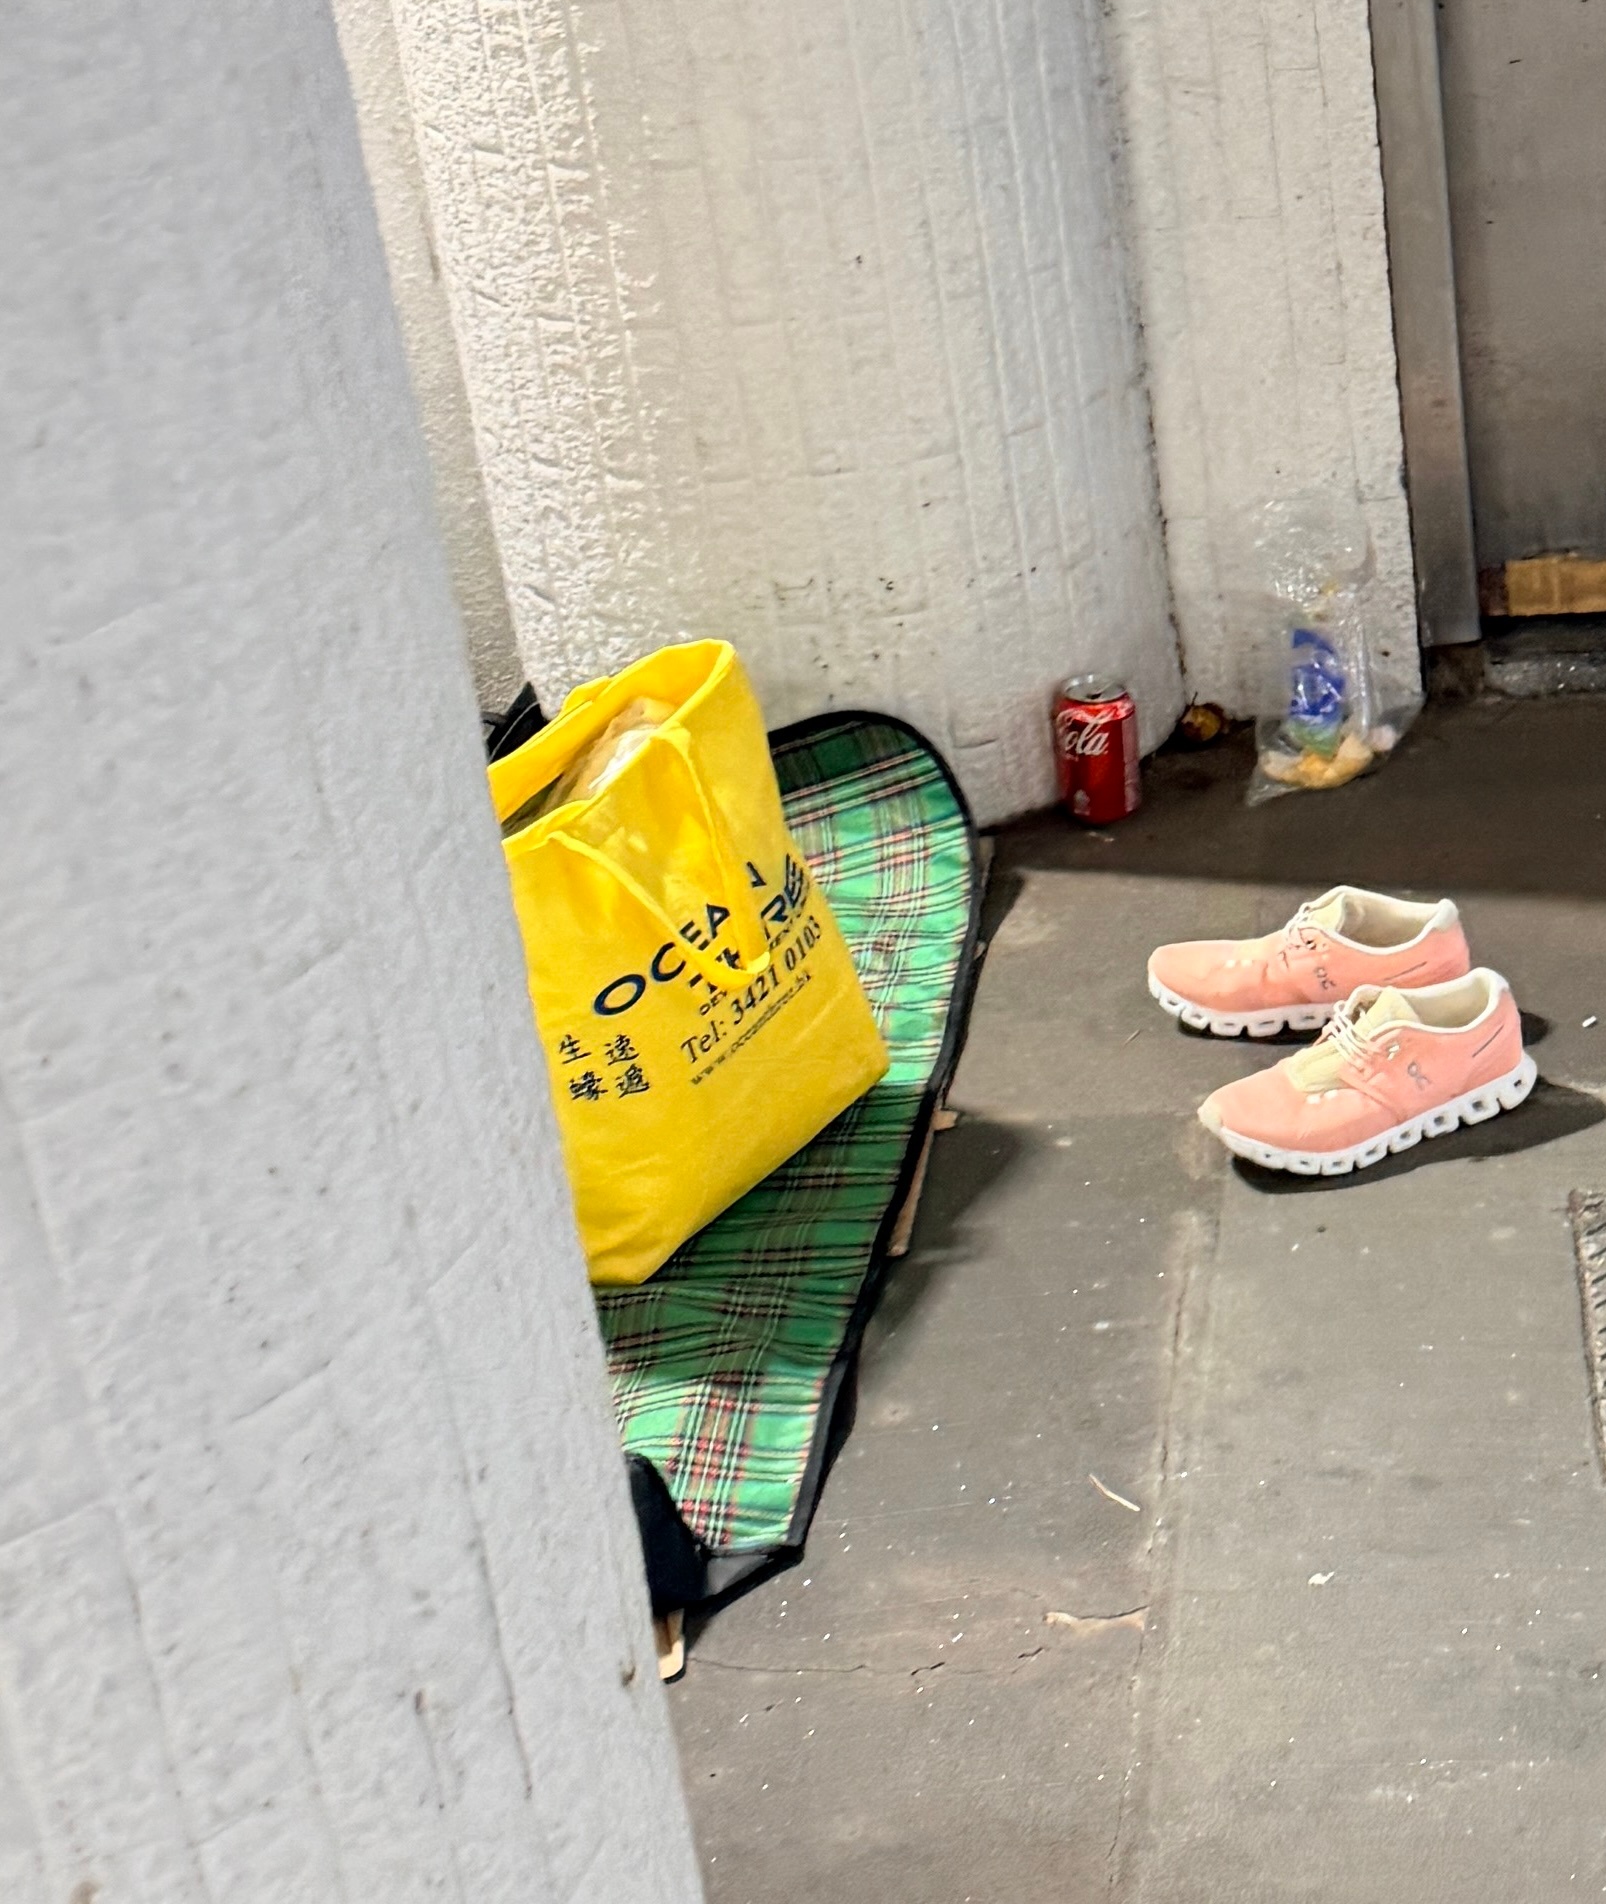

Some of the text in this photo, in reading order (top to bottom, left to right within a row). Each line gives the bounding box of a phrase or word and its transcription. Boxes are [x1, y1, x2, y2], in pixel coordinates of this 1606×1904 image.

[680, 1019, 728, 1064] Tel:
[731, 963, 780, 1026] 3421
[785, 914, 822, 972] 0103
